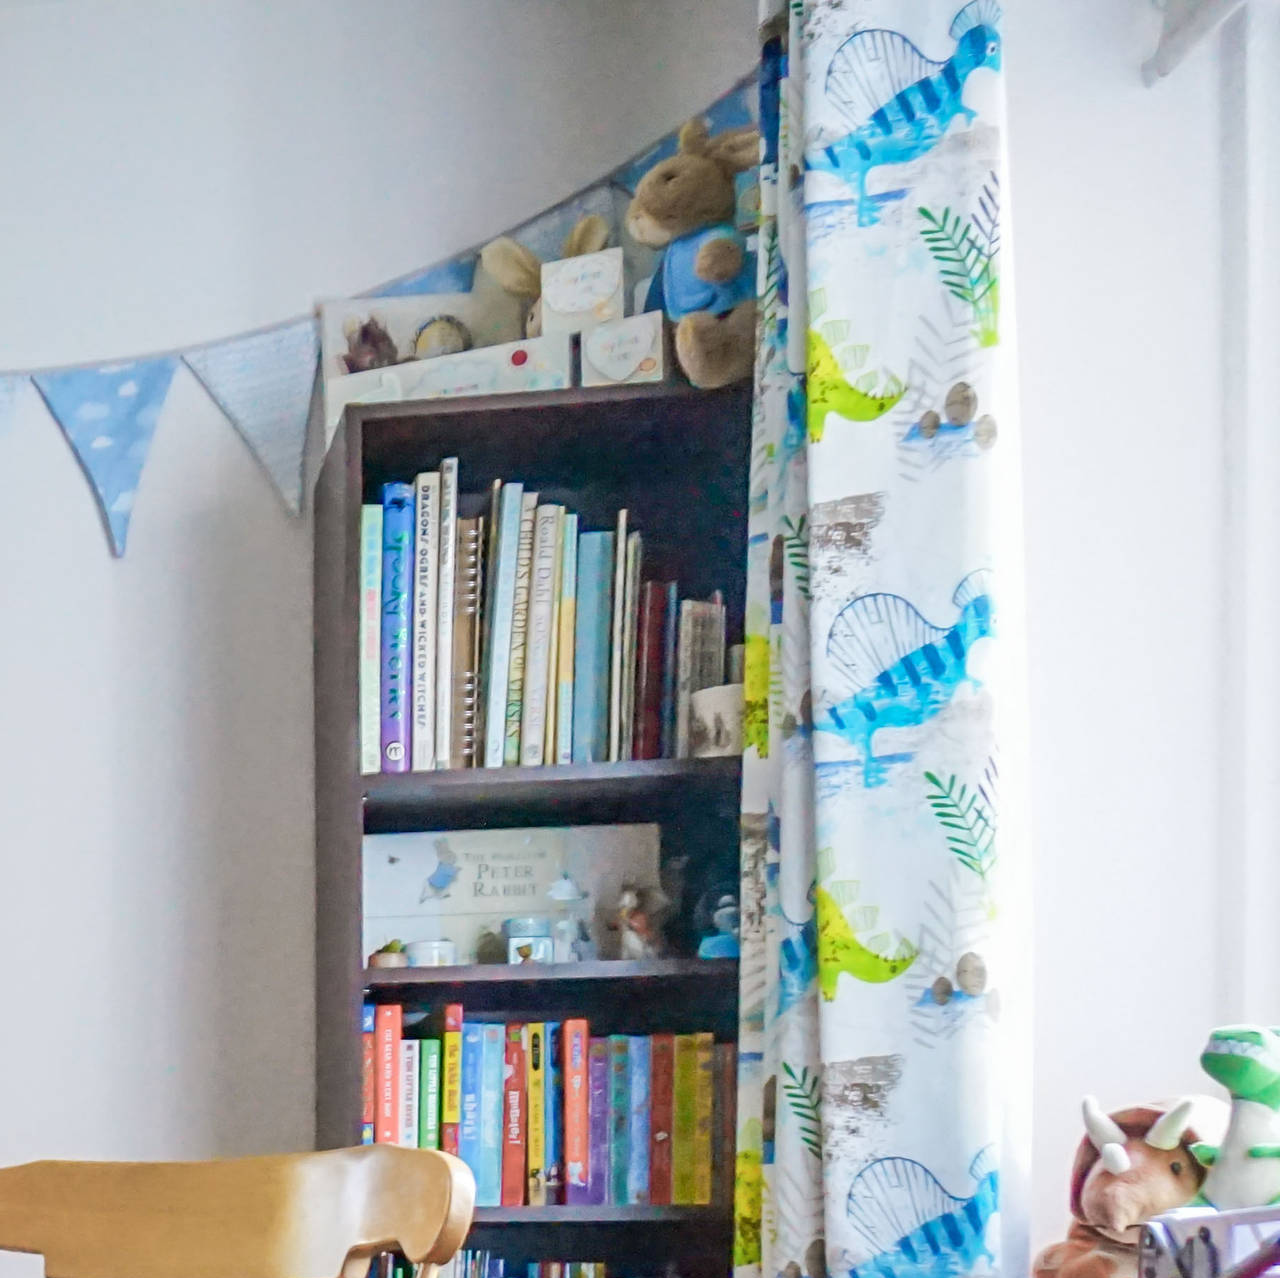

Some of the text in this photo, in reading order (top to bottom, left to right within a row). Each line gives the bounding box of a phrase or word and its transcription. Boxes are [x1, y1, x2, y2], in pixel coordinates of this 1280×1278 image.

[538, 515, 556, 560] Roald
[418, 548, 429, 586] OGRES
[535, 566, 553, 604] Dahl
[511, 584, 529, 651] GARDEN
